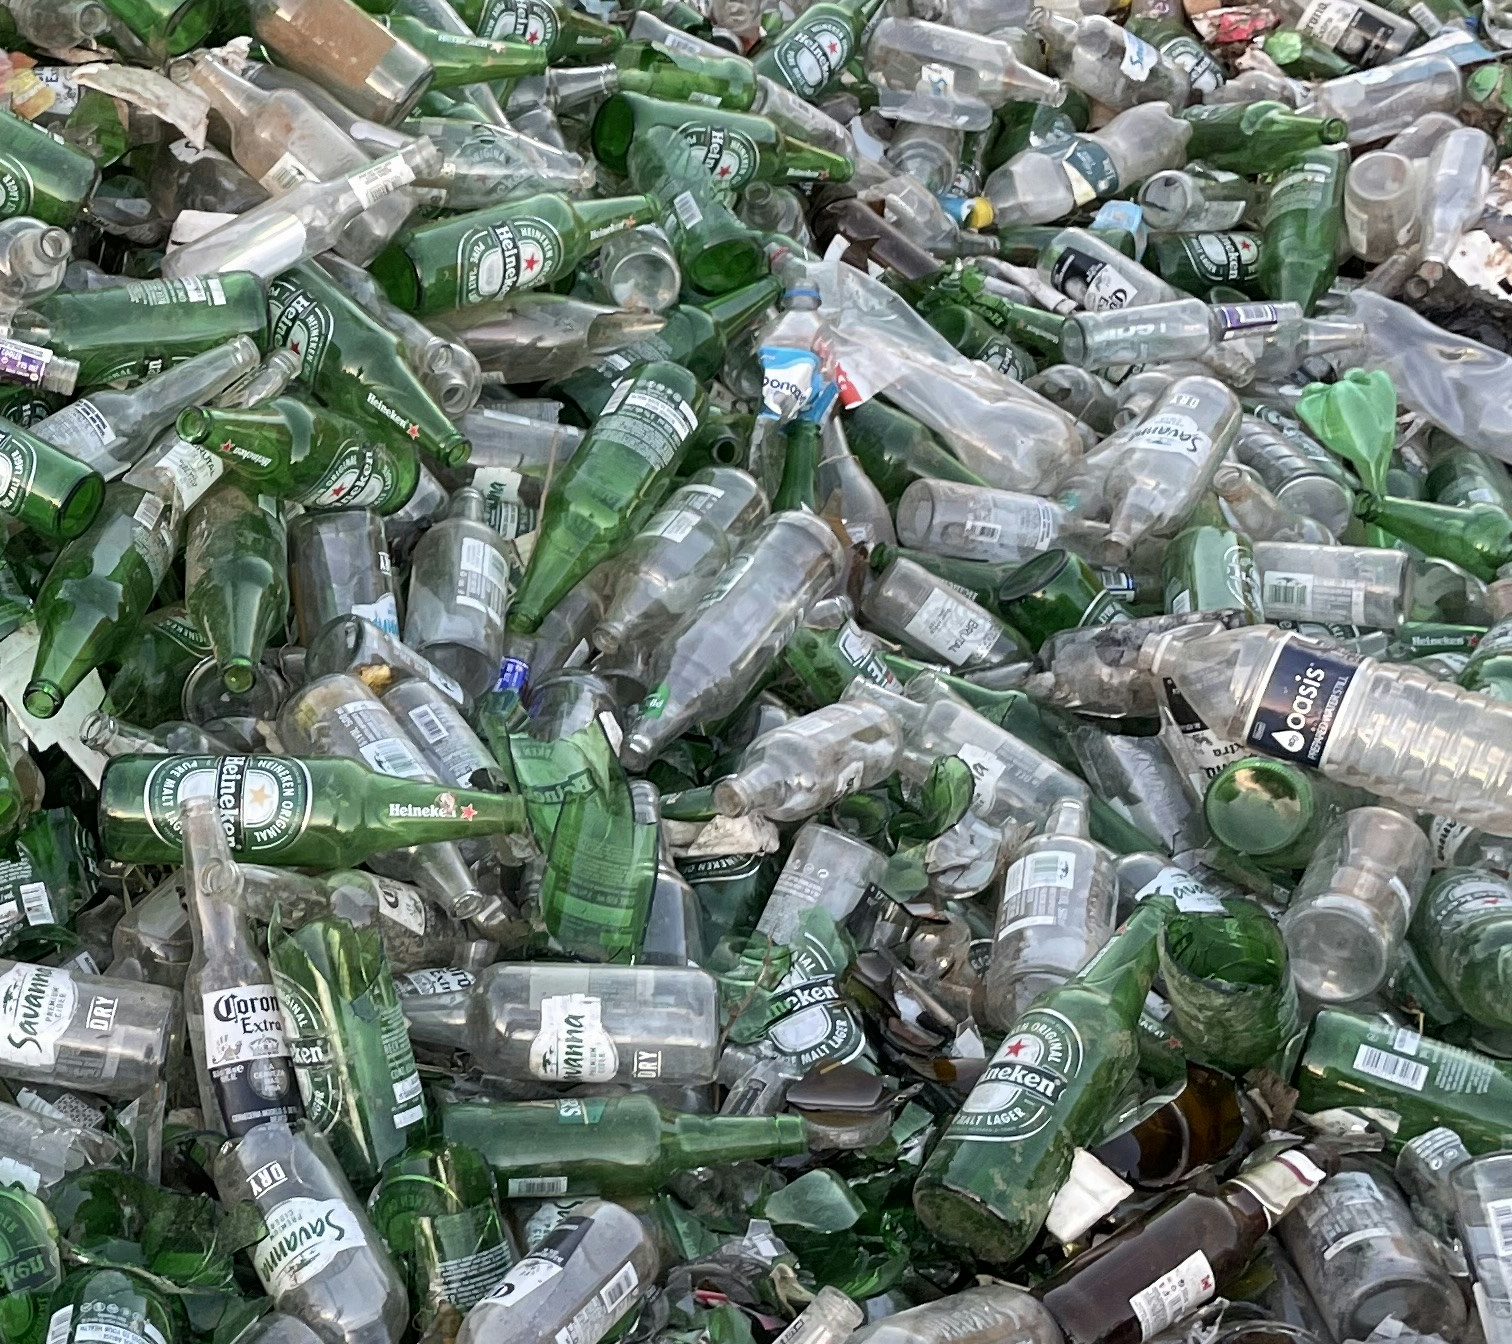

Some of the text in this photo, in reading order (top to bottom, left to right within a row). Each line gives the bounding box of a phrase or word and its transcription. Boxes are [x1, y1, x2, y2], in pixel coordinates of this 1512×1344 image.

[274, 294, 314, 351] Heine
[366, 390, 408, 429] Heineken
[1170, 394, 1201, 409] DRY
[1410, 635, 1464, 648] Heineken
[1289, 664, 1328, 732] oasis
[161, 760, 199, 808] PURE MALT
[253, 758, 295, 843] HEINEKEN ORIGINAL
[44, 985, 60, 1023] PREMIUM
[54, 991, 67, 1019] CIDER
[89, 995, 115, 1033] DRY
[213, 992, 280, 1025] Coron
[828, 1018, 849, 1055] LAGER
[1030, 1021, 1062, 1065] ORIGINAL
[635, 1050, 660, 1079] DRY
[985, 1108, 1027, 1125] LAGER
[250, 1164, 287, 1197] DRY
[260, 1209, 347, 1285] Savanna
